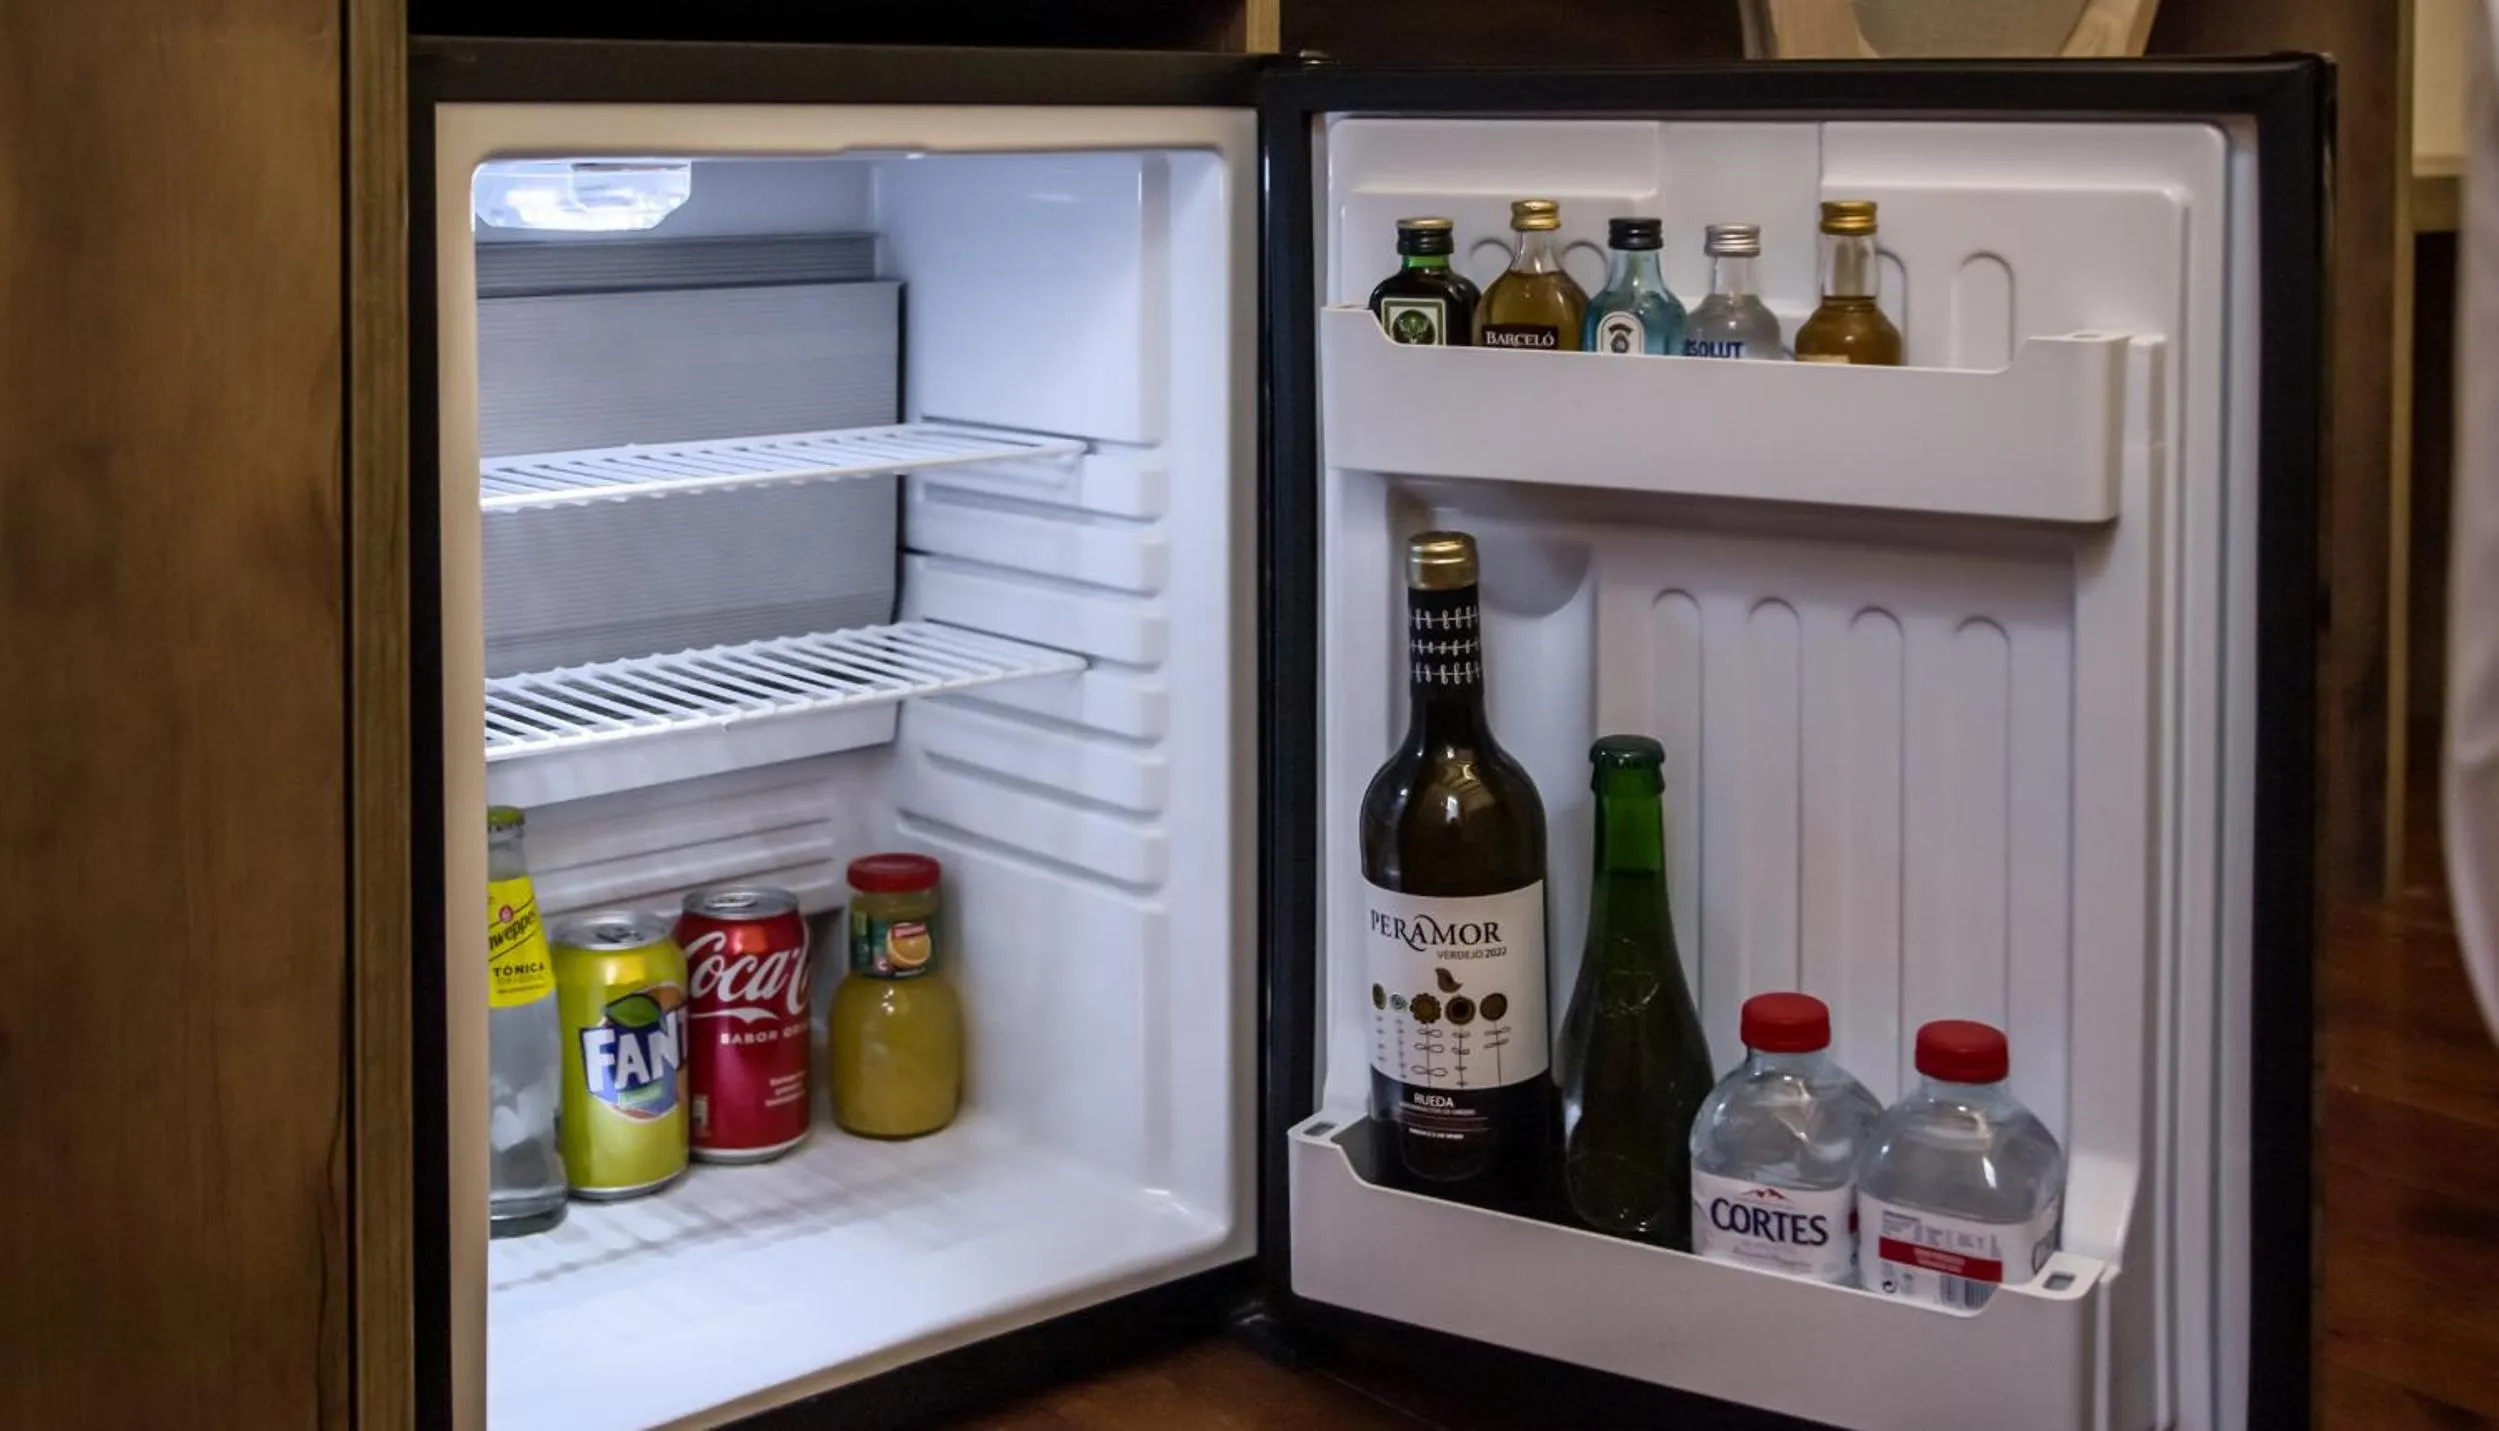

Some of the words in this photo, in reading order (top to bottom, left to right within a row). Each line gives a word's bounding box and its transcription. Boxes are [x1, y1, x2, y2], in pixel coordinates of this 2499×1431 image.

[1485, 330, 1556, 347] BARCELÓ
[1370, 909, 1502, 952] PERAMOR
[1413, 1092, 1455, 1108] RUEDA
[1710, 1198, 1830, 1246] CORTES
